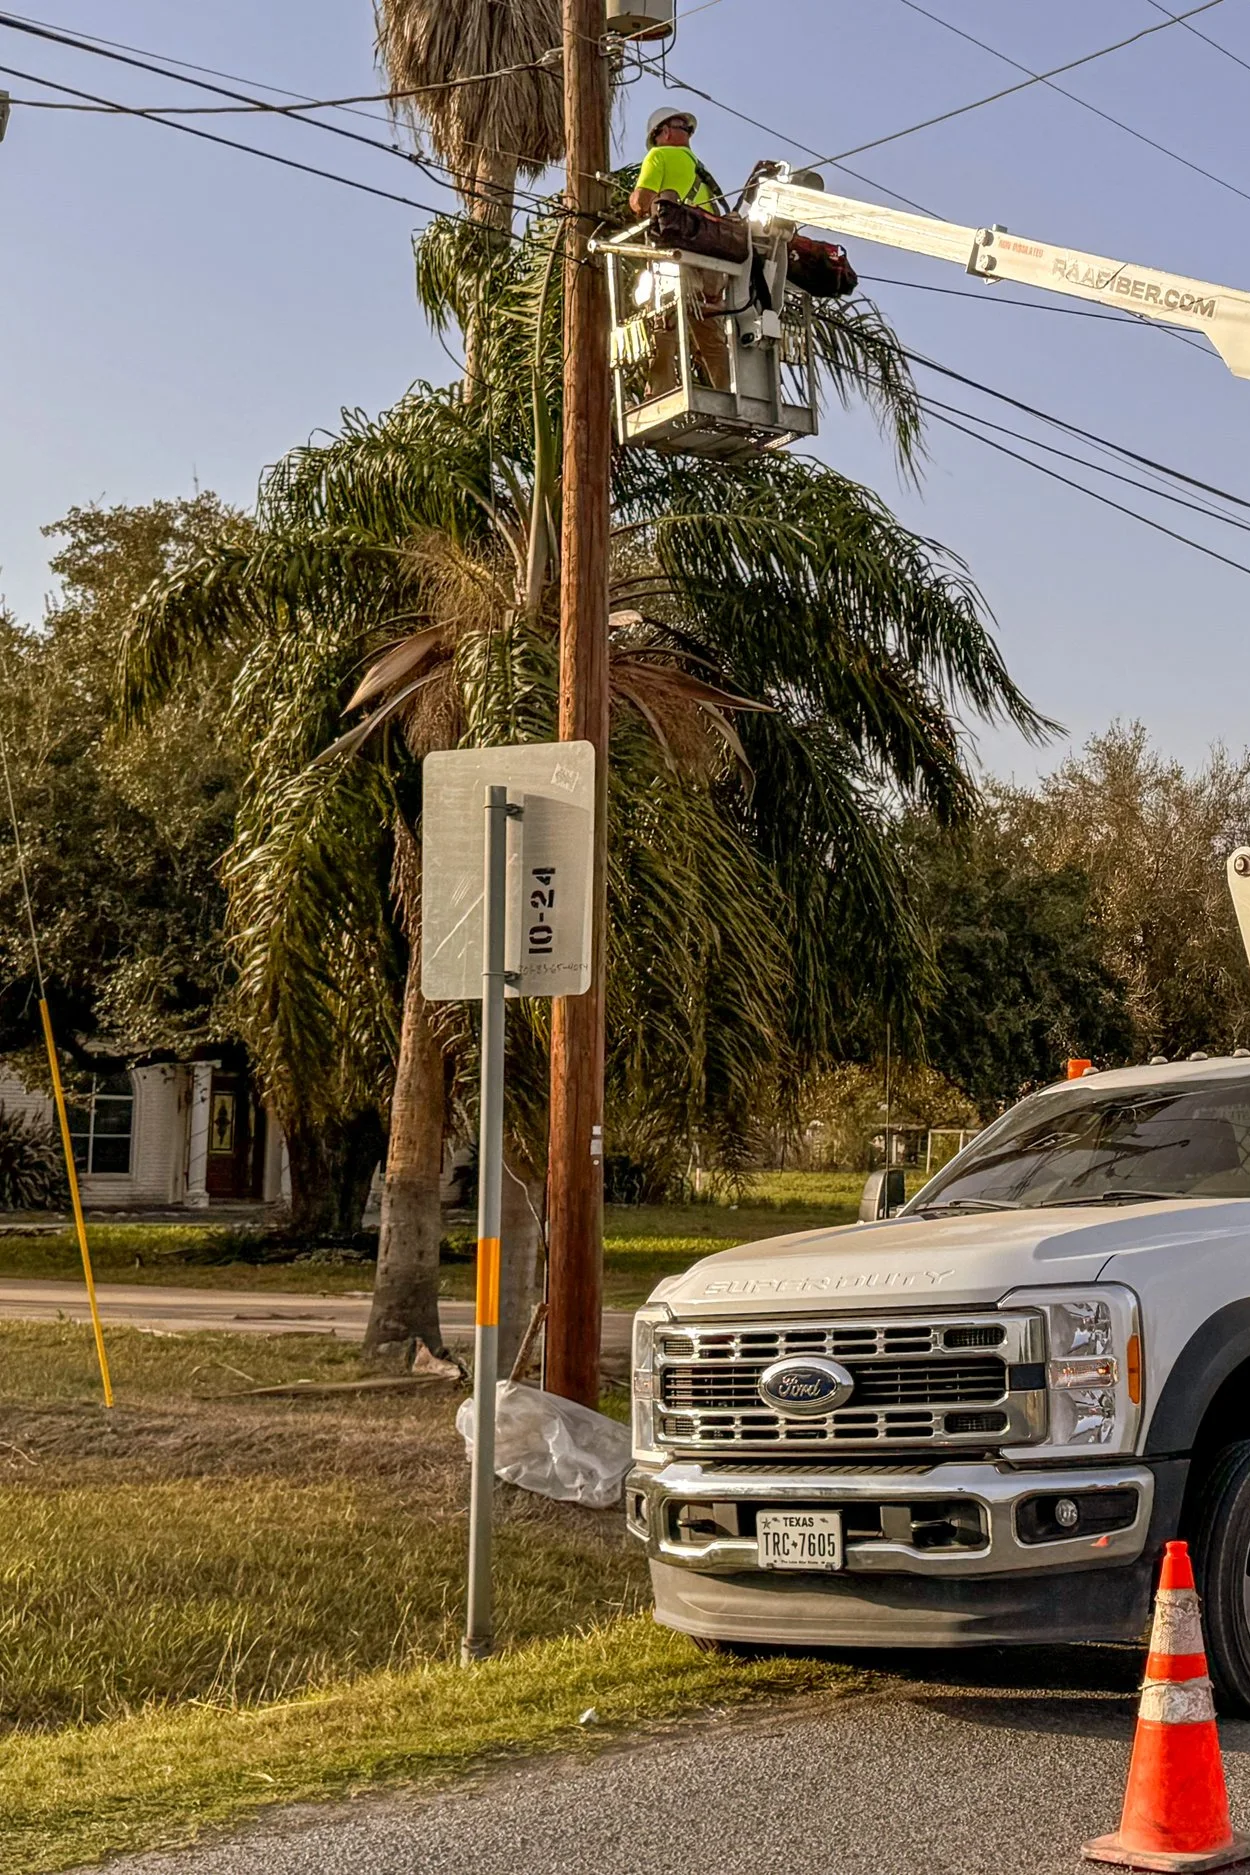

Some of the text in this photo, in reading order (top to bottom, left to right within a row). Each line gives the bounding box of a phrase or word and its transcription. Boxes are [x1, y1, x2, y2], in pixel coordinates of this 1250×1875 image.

[1052, 257, 1217, 318] RAAFIBER.COM
[528, 867, 556, 954] 10-24
[704, 1268, 956, 1295] SUPER DUTY
[778, 1373, 821, 1398] Ford
[782, 1516, 814, 1527] TEXAS
